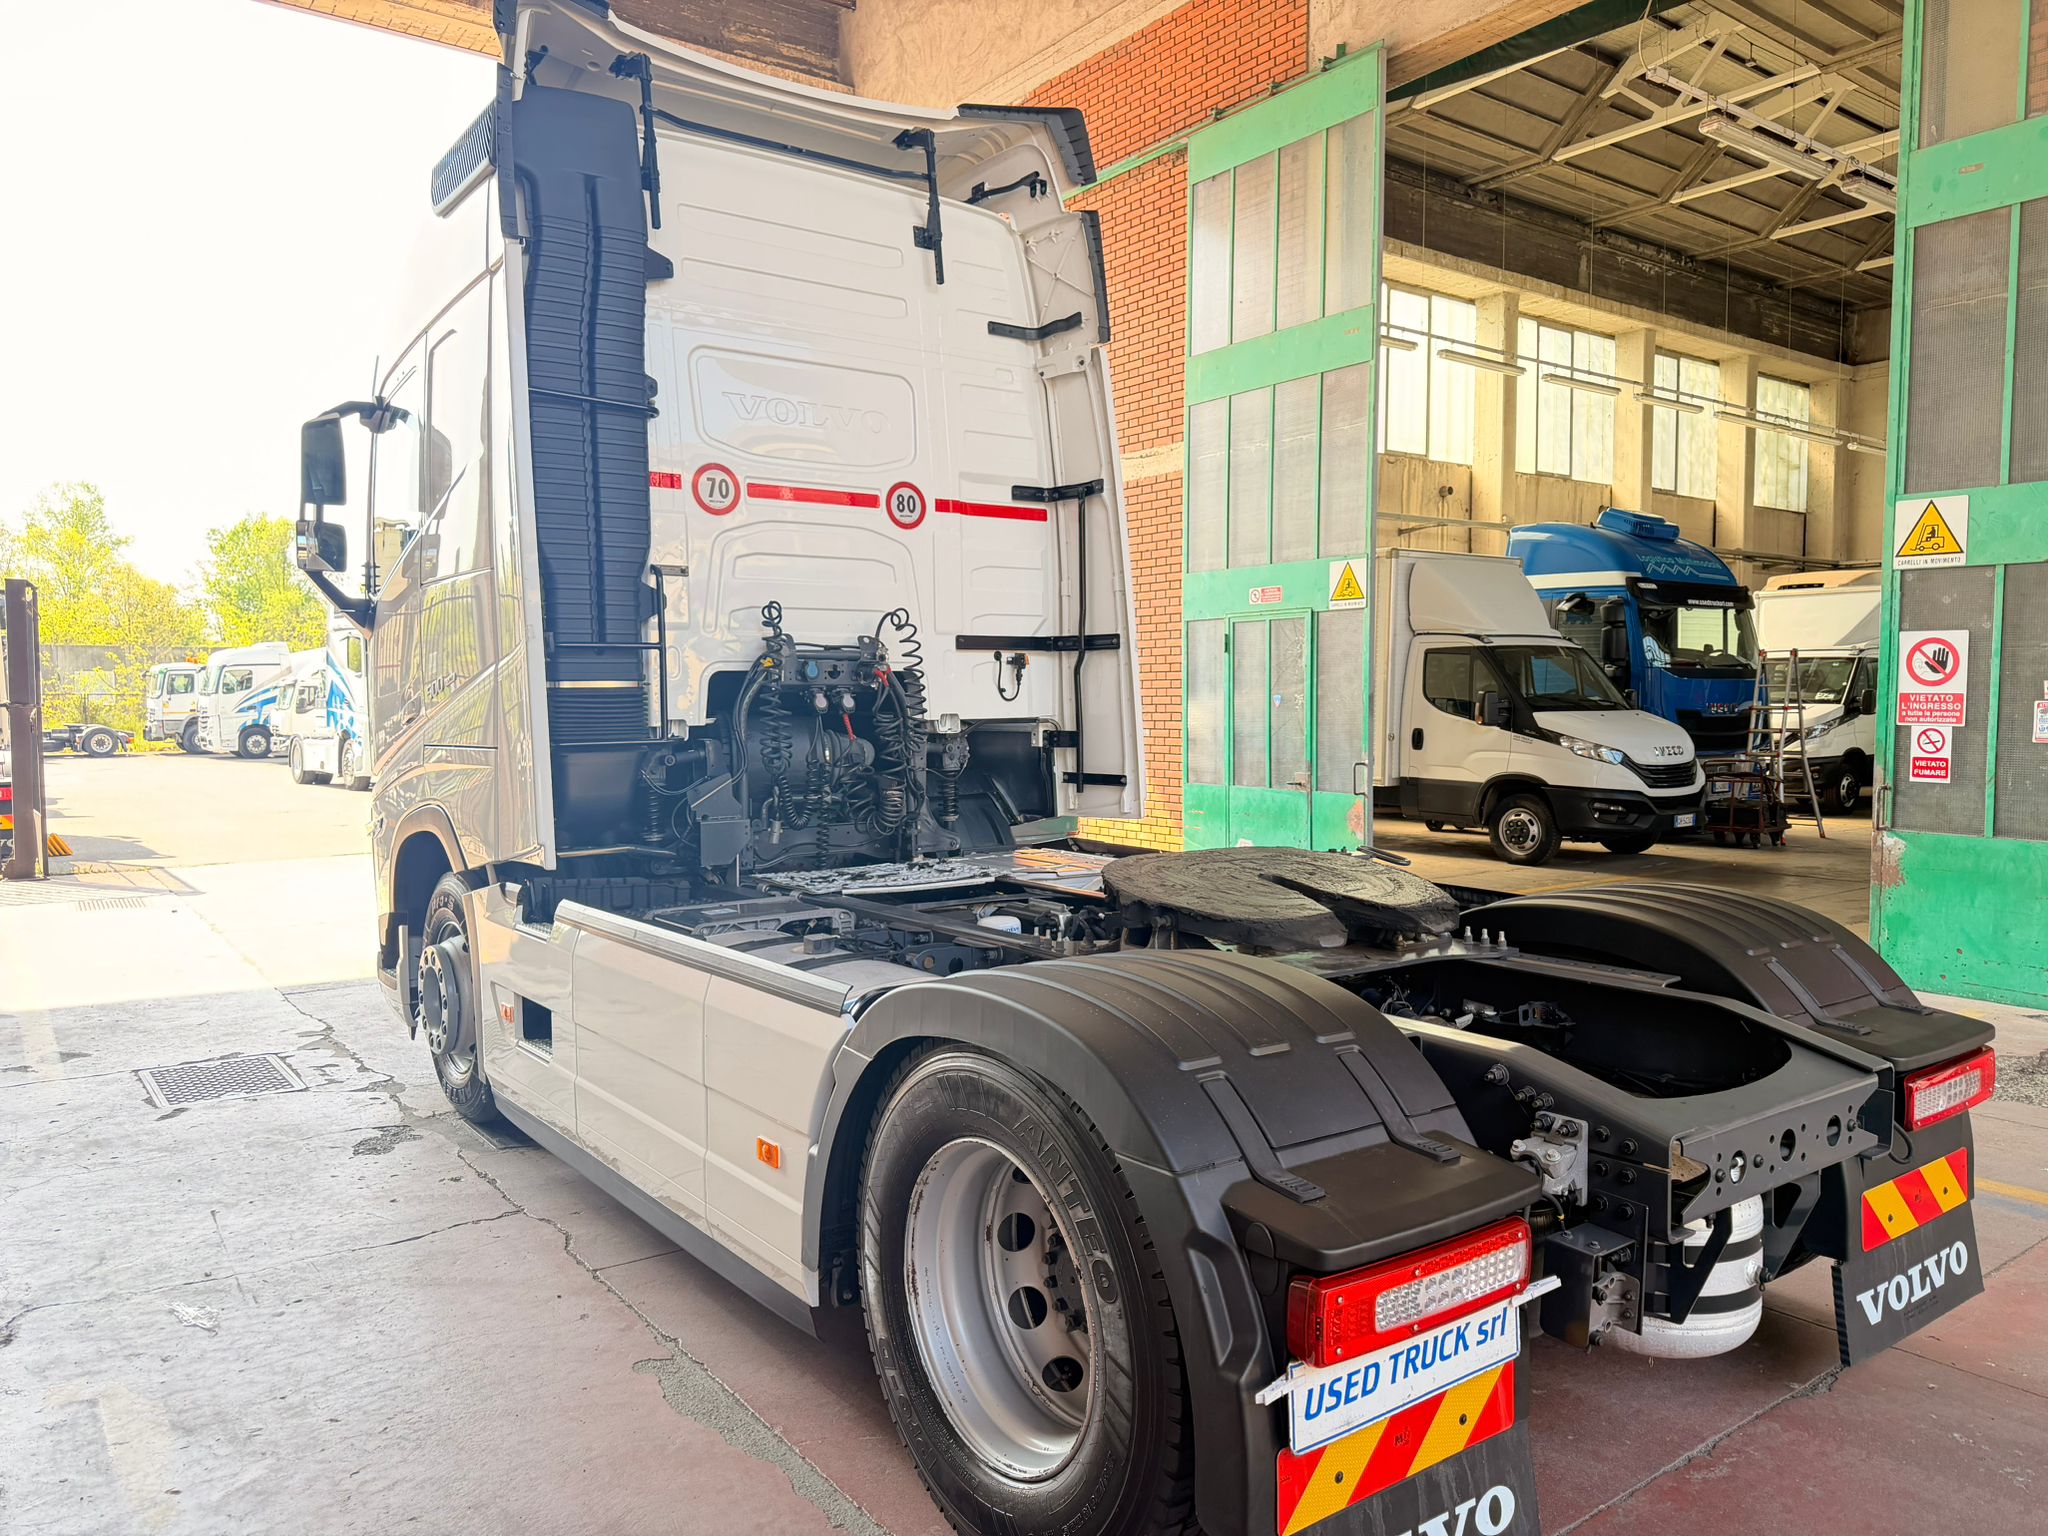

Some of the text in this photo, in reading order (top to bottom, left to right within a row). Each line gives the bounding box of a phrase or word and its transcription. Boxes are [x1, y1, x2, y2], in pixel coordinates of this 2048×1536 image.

[721, 391, 889, 434] VOLVO
[706, 477, 730, 500] 70
[896, 493, 916, 514] 80
[1897, 559, 1921, 567] CARRELLI
[1930, 556, 1961, 565] MOVIMENTO
[1901, 702, 1962, 710] L'INGRESSO
[1909, 694, 1954, 702] VIETATO
[1654, 745, 1685, 757] IVECO
[1913, 768, 1947, 776] FUMARE
[1856, 1240, 1968, 1326] VOLVO
[1304, 1306, 1509, 1421] USED TRUCK srl
